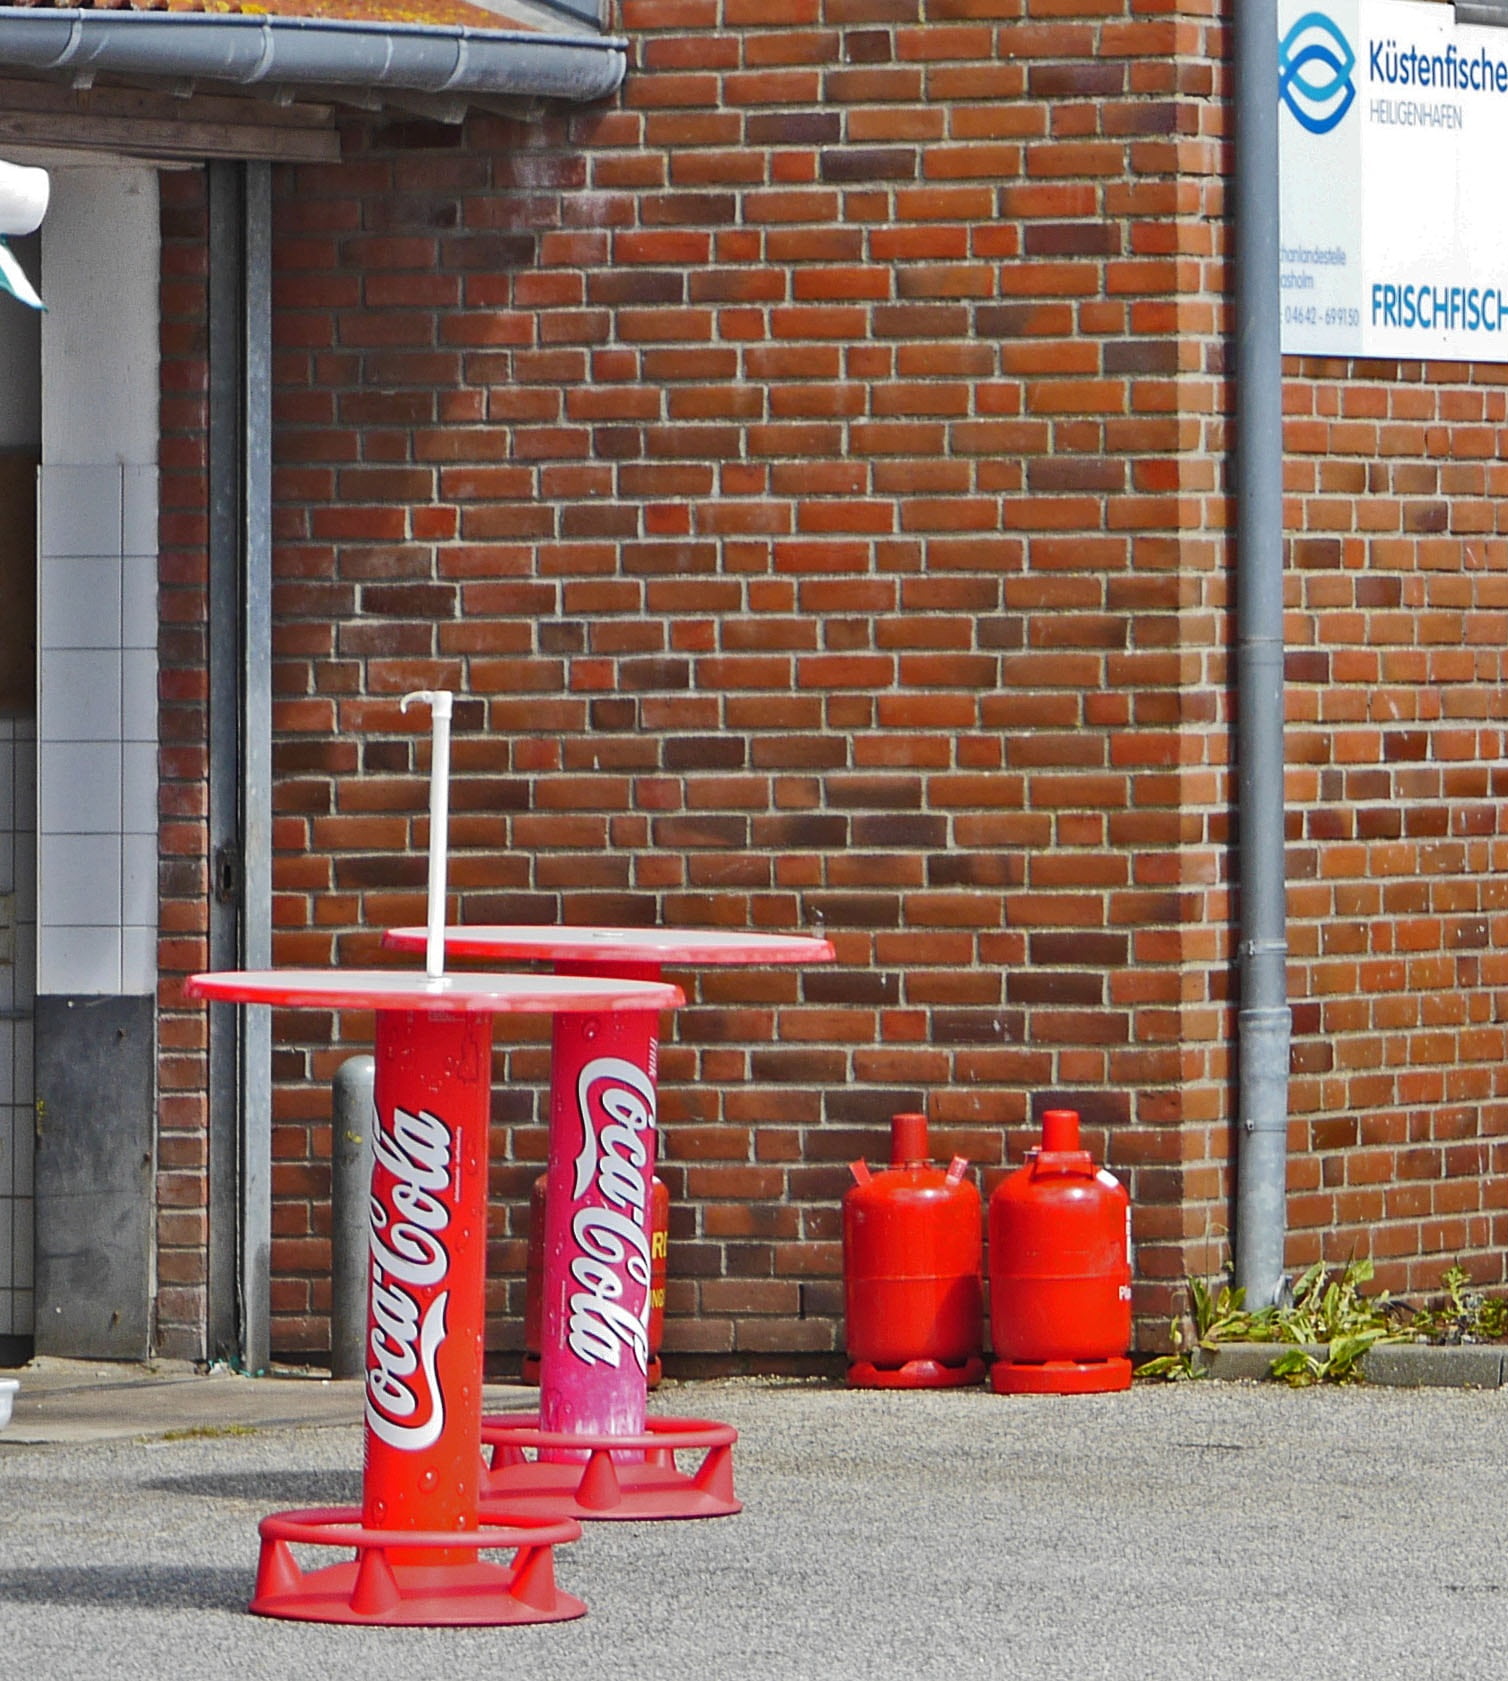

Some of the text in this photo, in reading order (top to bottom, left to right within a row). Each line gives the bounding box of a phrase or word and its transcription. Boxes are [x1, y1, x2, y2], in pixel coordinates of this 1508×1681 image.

[1369, 99, 1464, 130] HEILIGENHAFEN
[365, 1106, 453, 1451] Coca-Cola
[568, 1057, 657, 1377] Coca-Cola
